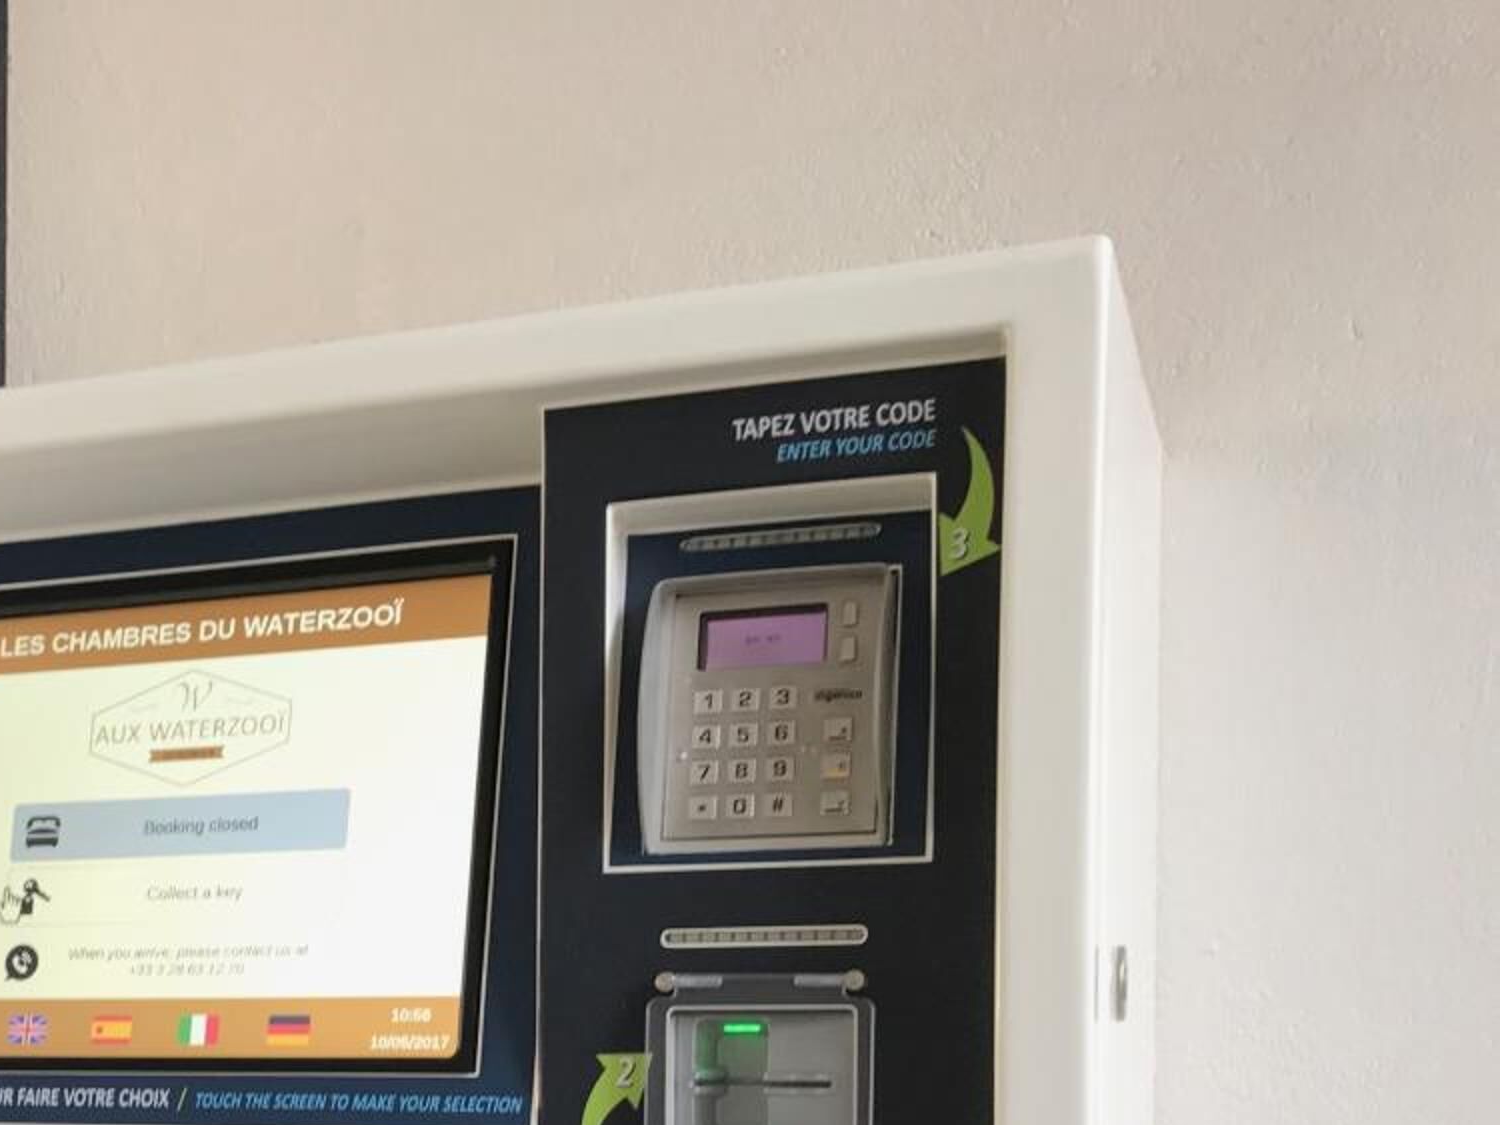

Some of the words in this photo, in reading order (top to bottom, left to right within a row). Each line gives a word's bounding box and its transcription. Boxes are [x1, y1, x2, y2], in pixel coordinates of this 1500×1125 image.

[732, 413, 795, 441] TAPEZ
[800, 405, 871, 434] VOTRE
[875, 398, 936, 425] CODE
[776, 441, 831, 463] ENTER
[835, 434, 883, 457] YOUR
[887, 428, 937, 451] CODE
[951, 527, 971, 558] 3
[0, 636, 45, 658] LES
[51, 622, 191, 654] CHAMBRES
[199, 618, 235, 642] DU
[243, 598, 405, 638] WATERZOOÏ
[704, 693, 713, 708] 1
[739, 691, 751, 707] 2
[777, 688, 790, 705] 3
[95, 722, 141, 746] AUX
[699, 728, 712, 744] 4
[737, 728, 749, 743] 5
[775, 725, 789, 741] 6
[700, 764, 711, 780] 7
[735, 763, 748, 779] 8
[773, 760, 787, 777] 9
[733, 799, 746, 814] 0
[143, 818, 205, 836] Booking
[209, 816, 259, 832] closed
[147, 884, 198, 900] Collect
[202, 889, 212, 899] a
[216, 884, 243, 902] key
[616, 1056, 634, 1088] 2
[17, 1087, 60, 1108] FAIRE
[63, 1087, 115, 1109] VOTRE
[120, 1088, 170, 1109] CHOIX
[195, 1091, 242, 1110] TOUCH
[245, 1092, 271, 1110] THE
[271, 1093, 326, 1111] SCREEN
[330, 1093, 350, 1111] TO
[351, 1094, 396, 1112] MAKE
[399, 1095, 441, 1113] YOUR
[442, 1095, 523, 1114] SELECTION
